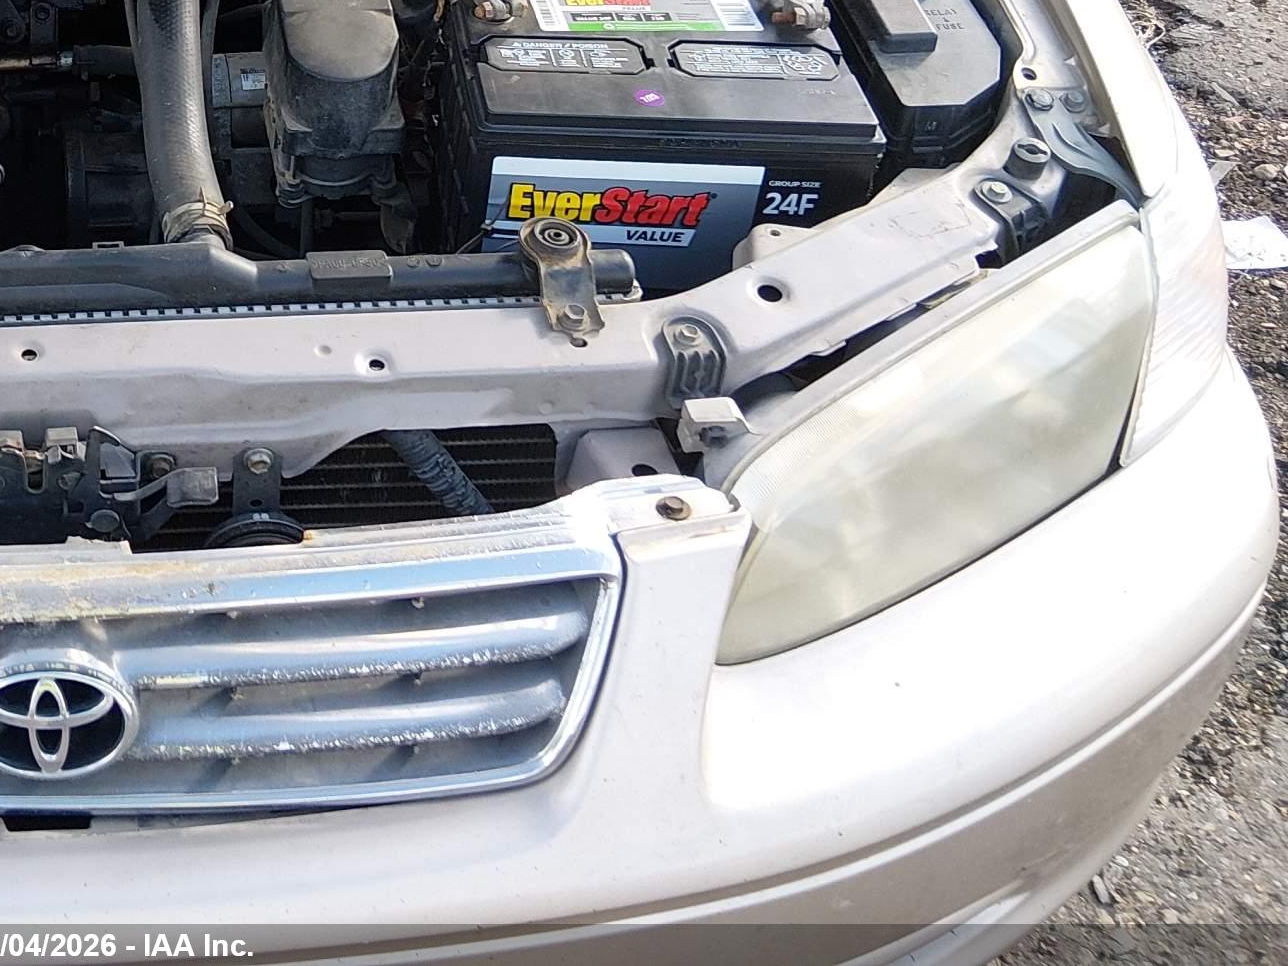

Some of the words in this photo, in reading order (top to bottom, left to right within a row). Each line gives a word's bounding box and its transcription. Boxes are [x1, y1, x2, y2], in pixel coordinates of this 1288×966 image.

[935, 23, 966, 31] FUSE
[768, 180, 801, 188] GROUP
[507, 182, 711, 228] EverStart
[762, 191, 820, 216] 24F
[624, 229, 685, 243] VALUE
